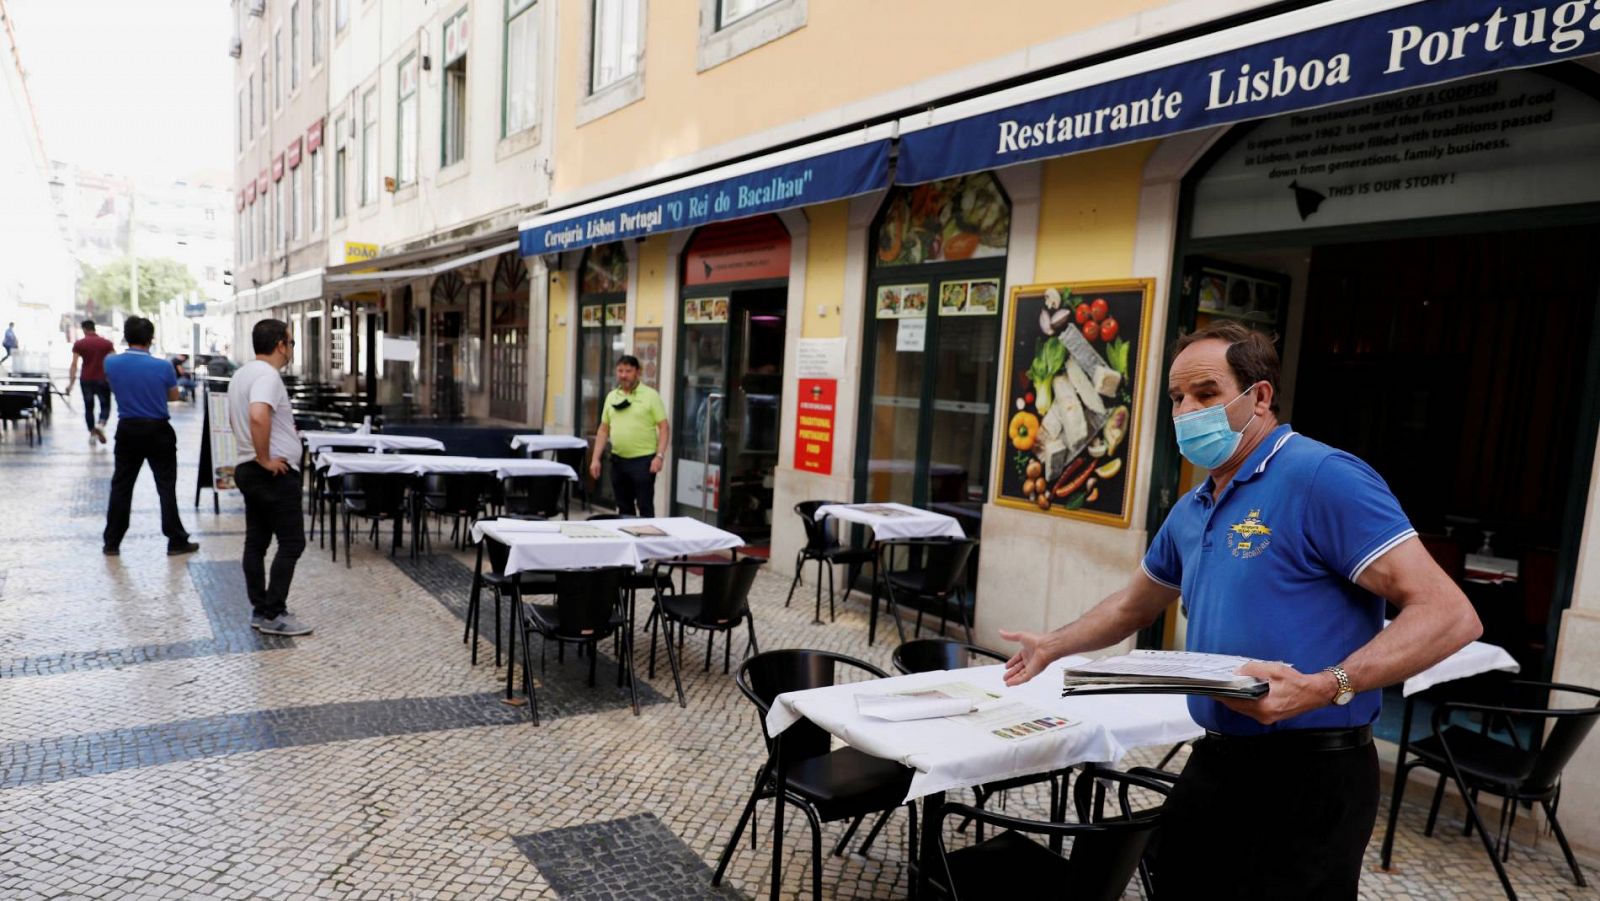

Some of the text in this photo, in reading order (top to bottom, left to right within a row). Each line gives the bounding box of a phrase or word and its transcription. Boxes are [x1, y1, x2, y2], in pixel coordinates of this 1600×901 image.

[996, 87, 1184, 155] Restaurante
[1204, 51, 1352, 112] Lisboa
[1257, 137, 1283, 150] open
[1285, 131, 1312, 144] since
[1315, 125, 1342, 139] 1962
[1347, 123, 1357, 134] is
[1359, 121, 1380, 133] one
[1383, 115, 1397, 128] of
[1399, 112, 1420, 125] the
[1422, 108, 1455, 122] firsts
[1457, 100, 1506, 117] houses
[1509, 93, 1526, 108] of
[1527, 88, 1556, 105] cod
[1290, 81, 1498, 127] The restaurant KING OF A CODFISH
[1245, 156, 1254, 166] in
[1295, 149, 1308, 159] an
[1310, 144, 1329, 157] old
[1330, 140, 1365, 154] house
[1367, 132, 1399, 149] filled
[1401, 128, 1429, 144] with
[1432, 119, 1498, 139] traditions
[1501, 109, 1553, 131] passed
[1269, 137, 1510, 178] down from generations, family business.
[544, 169, 813, 248] Cervejaria Lisboa Portugal "O Rei do Bacalhau"
[1328, 183, 1355, 197] THIS
[1358, 181, 1370, 194] IS
[1374, 178, 1401, 193] OUR
[1405, 172, 1449, 189] STORY
